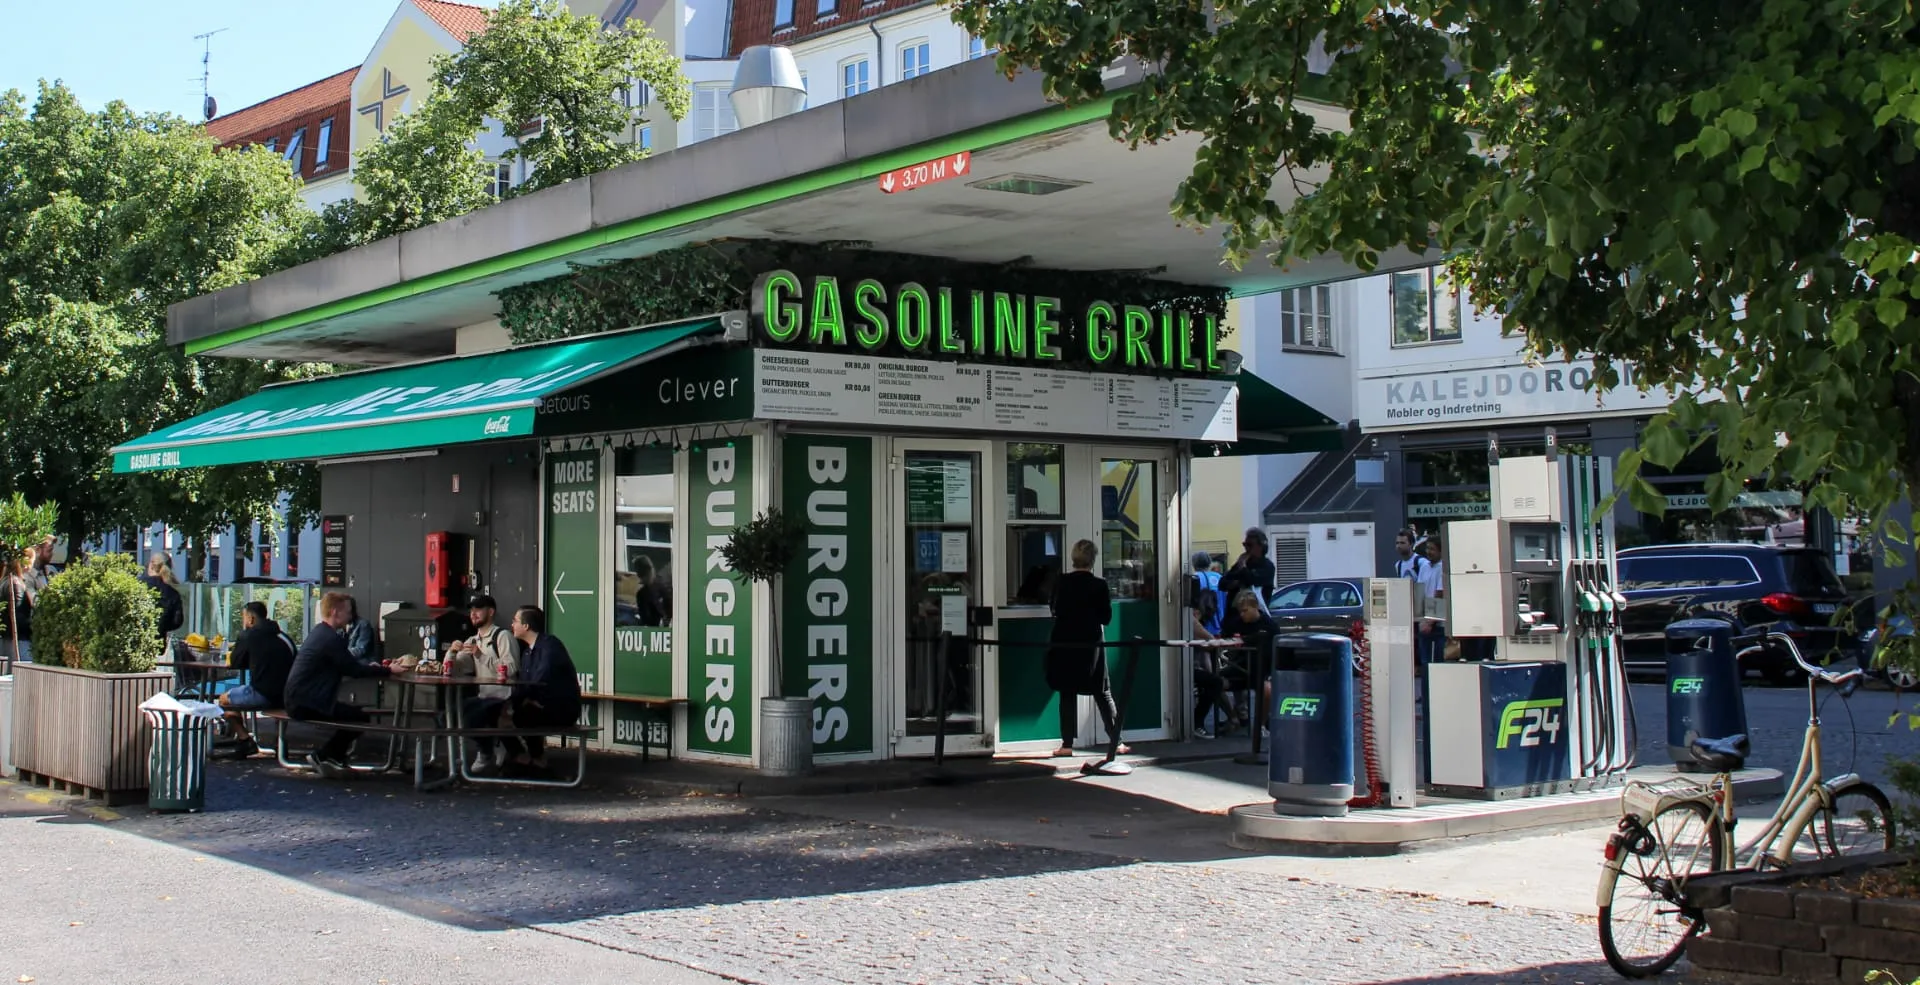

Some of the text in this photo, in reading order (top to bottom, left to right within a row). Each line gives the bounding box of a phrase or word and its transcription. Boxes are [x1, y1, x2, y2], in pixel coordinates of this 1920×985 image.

[902, 160, 945, 187] 3.70 M
[755, 269, 1228, 375] GASOLINE GRILL
[762, 356, 809, 366] CHEESEBURGER
[878, 363, 929, 373] ORIGINAL BURGER
[659, 376, 739, 404] Clever
[762, 379, 809, 388] BUTTERBURGER
[878, 392, 921, 401] GREEN BURGER
[1427, 407, 1440, 417] og
[1443, 401, 1501, 414] Indretning
[1490, 440, 1497, 450] A
[1547, 435, 1554, 446] B
[130, 451, 180, 469] GASOLINE GRILL
[554, 460, 594, 484] MORE
[552, 489, 595, 514] SEATS
[806, 445, 849, 744] BURGERS
[616, 630, 671, 656] YOU, ME
[1672, 678, 1704, 693] F24
[1280, 697, 1320, 716] F24
[1496, 698, 1563, 749] F24
